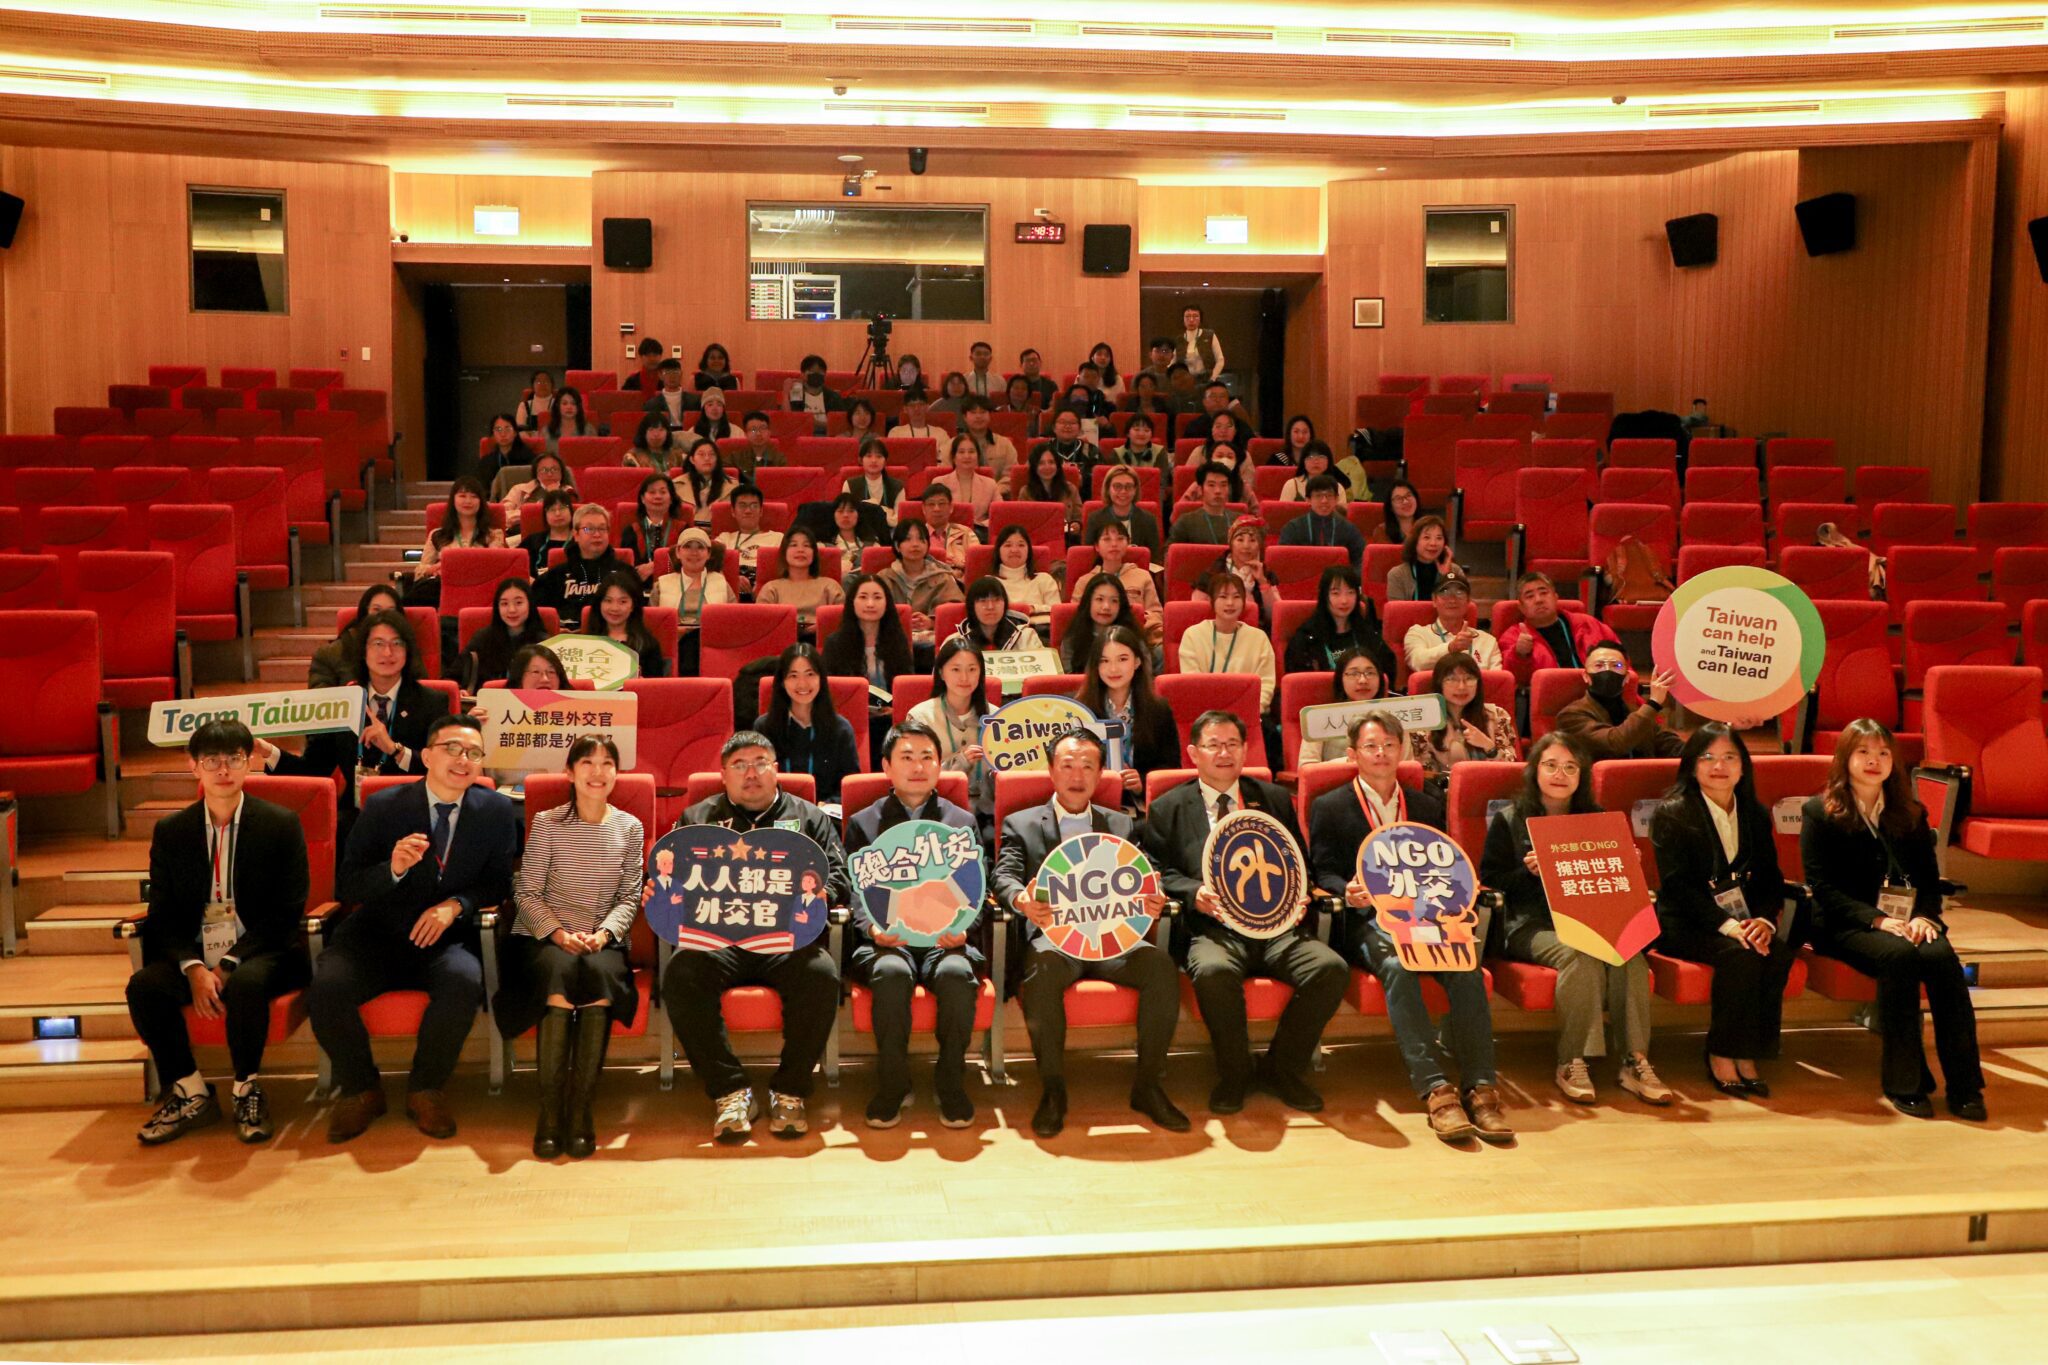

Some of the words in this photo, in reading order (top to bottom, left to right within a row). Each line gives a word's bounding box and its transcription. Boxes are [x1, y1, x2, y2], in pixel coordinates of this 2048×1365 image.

[1706, 606, 1778, 631] Taiwan
[1702, 627, 1733, 641] can
[1737, 629, 1775, 649] help
[1700, 648, 1716, 656] and
[1717, 645, 1772, 664] Taiwan
[1697, 660, 1728, 673] can
[1732, 662, 1769, 680] lead
[248, 698, 350, 727] Taiwan
[500, 709, 614, 727] 人人都是外交官
[499, 732, 613, 748] 部部都是外
[994, 748, 1039, 771] Can
[1372, 840, 1455, 867] NGO
[1550, 843, 1579, 853] 外交部
[1596, 840, 1618, 849] NGO
[852, 832, 979, 889] 總合外交
[1228, 839, 1282, 904] 外
[1555, 857, 1624, 877] 擁抱世界
[682, 864, 794, 895] 人人都是
[1048, 866, 1143, 905] NGO
[1387, 868, 1455, 910] 外交
[1561, 876, 1631, 896] 愛在台灣
[695, 897, 779, 927] 外交官
[1052, 900, 1144, 926] TAIWAN
